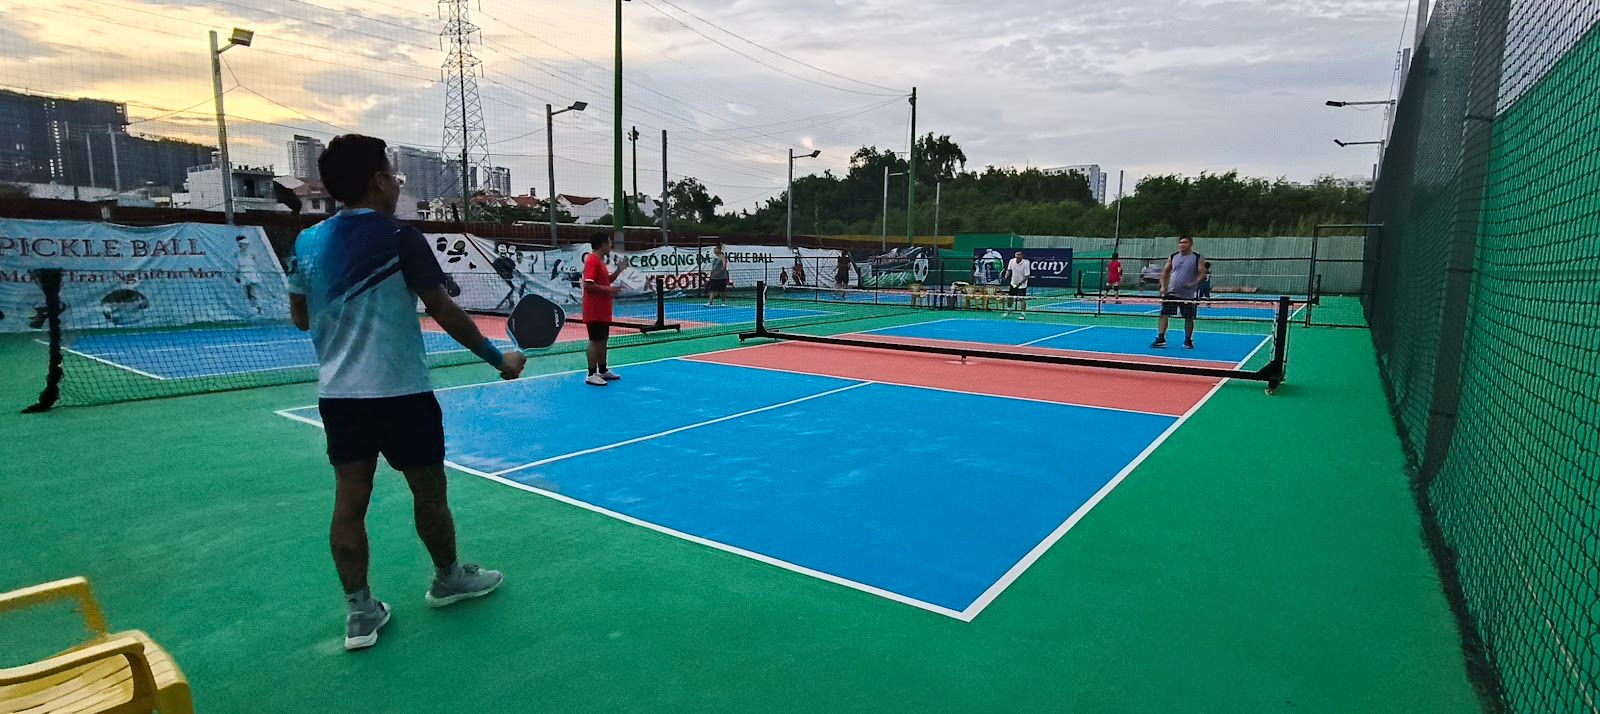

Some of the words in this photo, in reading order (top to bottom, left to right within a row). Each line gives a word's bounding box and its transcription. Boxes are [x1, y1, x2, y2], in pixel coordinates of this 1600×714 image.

[0, 237, 123, 258] PICKLE
[130, 238, 206, 258] BALL
[752, 252, 774, 263] BALL
